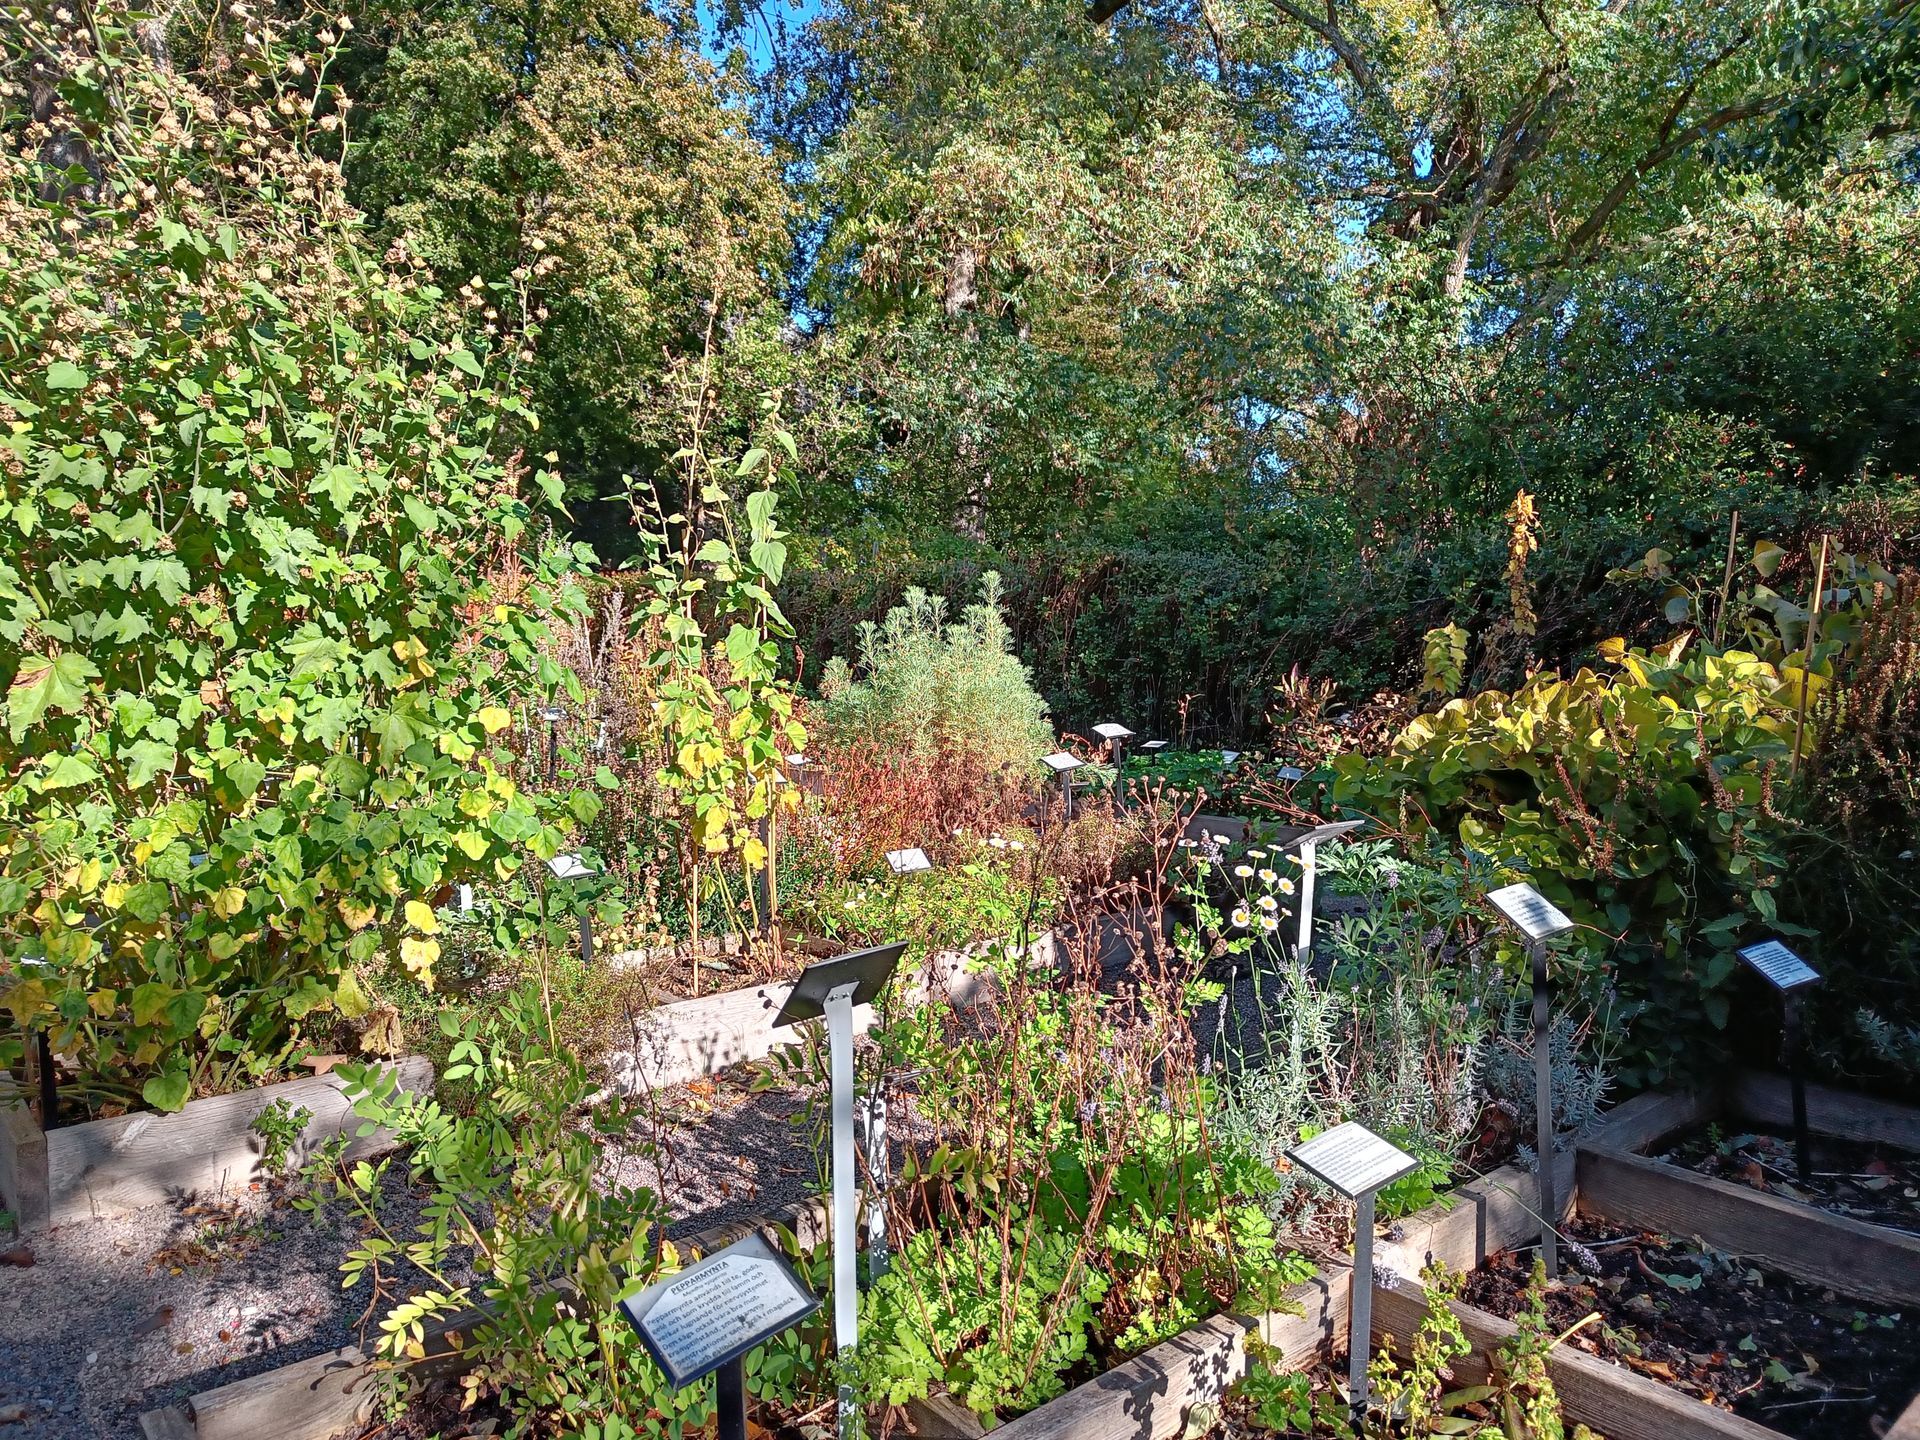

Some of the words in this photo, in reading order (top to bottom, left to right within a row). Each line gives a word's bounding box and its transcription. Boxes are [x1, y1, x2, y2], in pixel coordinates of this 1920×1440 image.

[667, 1316, 682, 1326] och
[682, 1308, 698, 1319] som
[697, 1294, 722, 1310] krydda
[721, 1288, 732, 1296] till
[731, 1278, 751, 1291] lamm
[750, 1271, 764, 1281] och
[670, 1261, 729, 1295] PEPPARMYNTA
[646, 1299, 695, 1328] Pepparmynta
[693, 1283, 722, 1301] används
[721, 1278, 732, 1286] till
[656, 1328, 680, 1343] verkar
[680, 1309, 715, 1331] lugnande
[713, 1303, 724, 1311] för
[662, 1339, 679, 1351] Den
[678, 1331, 695, 1343] sägs
[694, 1319, 715, 1333] också
[714, 1310, 731, 1321] vara
[730, 1303, 744, 1313] bra
[673, 1334, 729, 1367] menstruationer
[728, 1324, 746, 1336] samt
